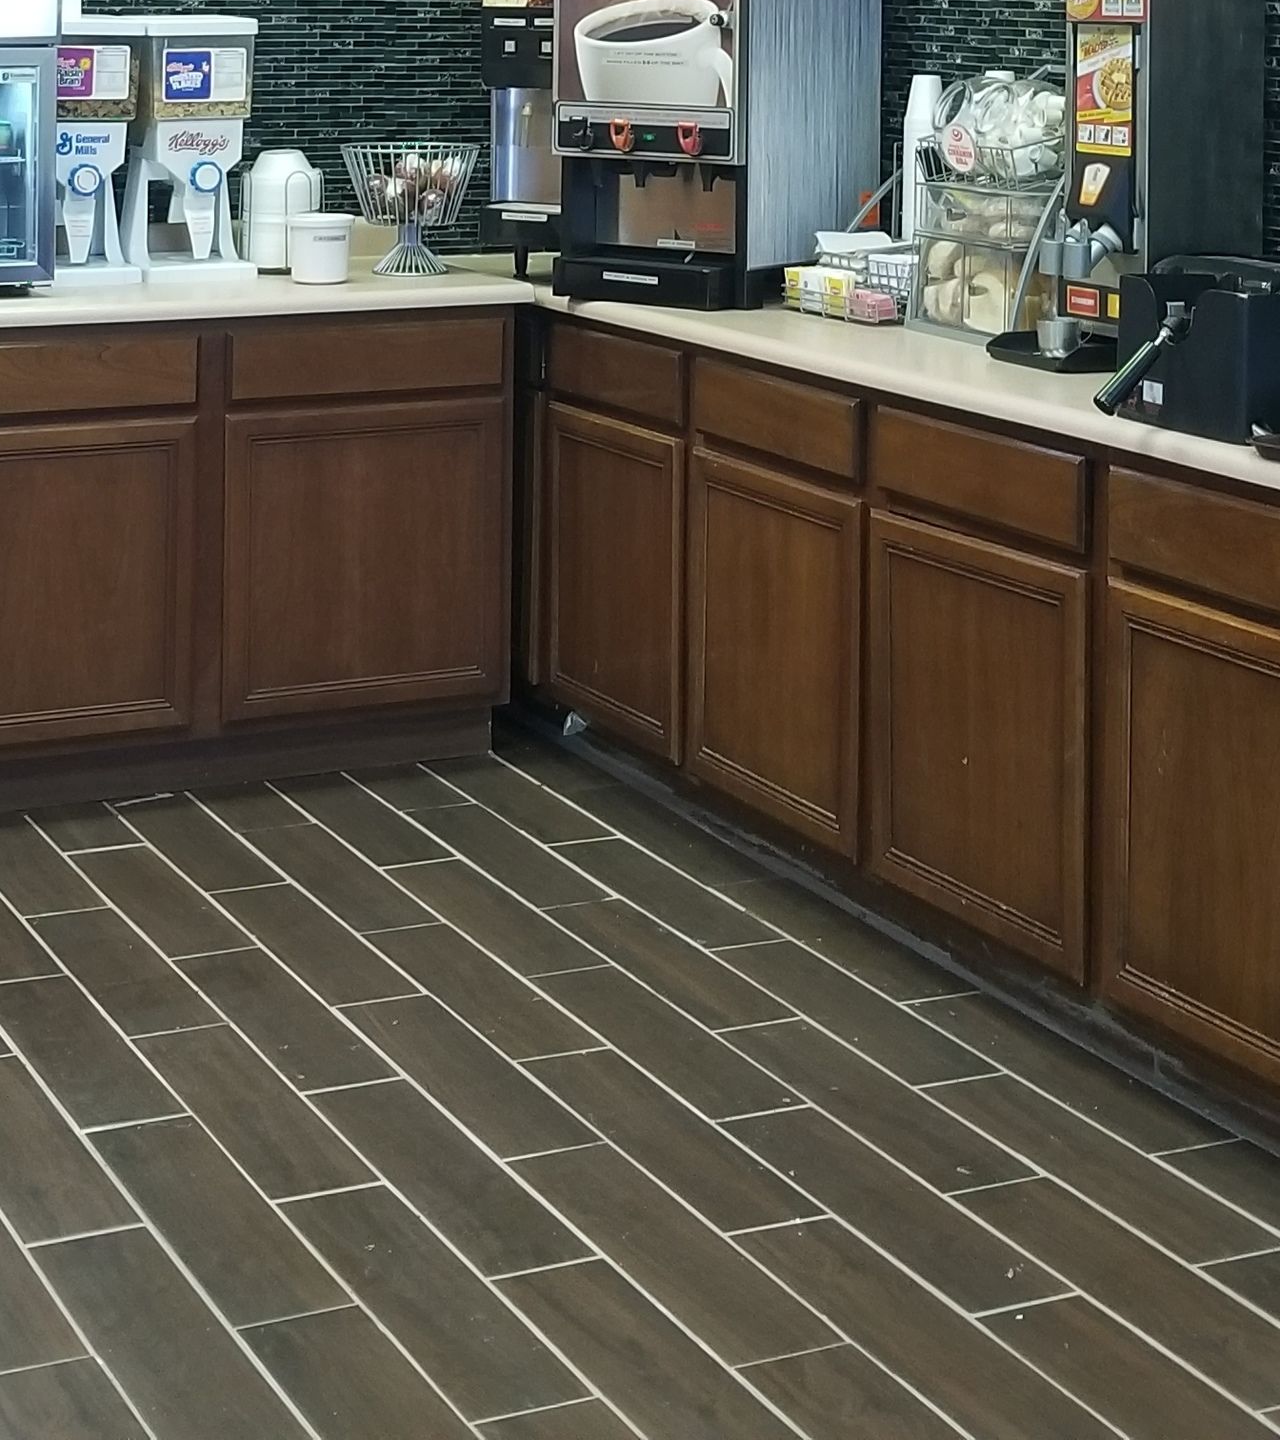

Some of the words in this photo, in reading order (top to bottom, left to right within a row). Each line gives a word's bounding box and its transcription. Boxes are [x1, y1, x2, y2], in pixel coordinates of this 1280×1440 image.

[75, 133, 110, 144] General
[168, 130, 229, 156] Kellogg's
[75, 145, 97, 155] Mills
